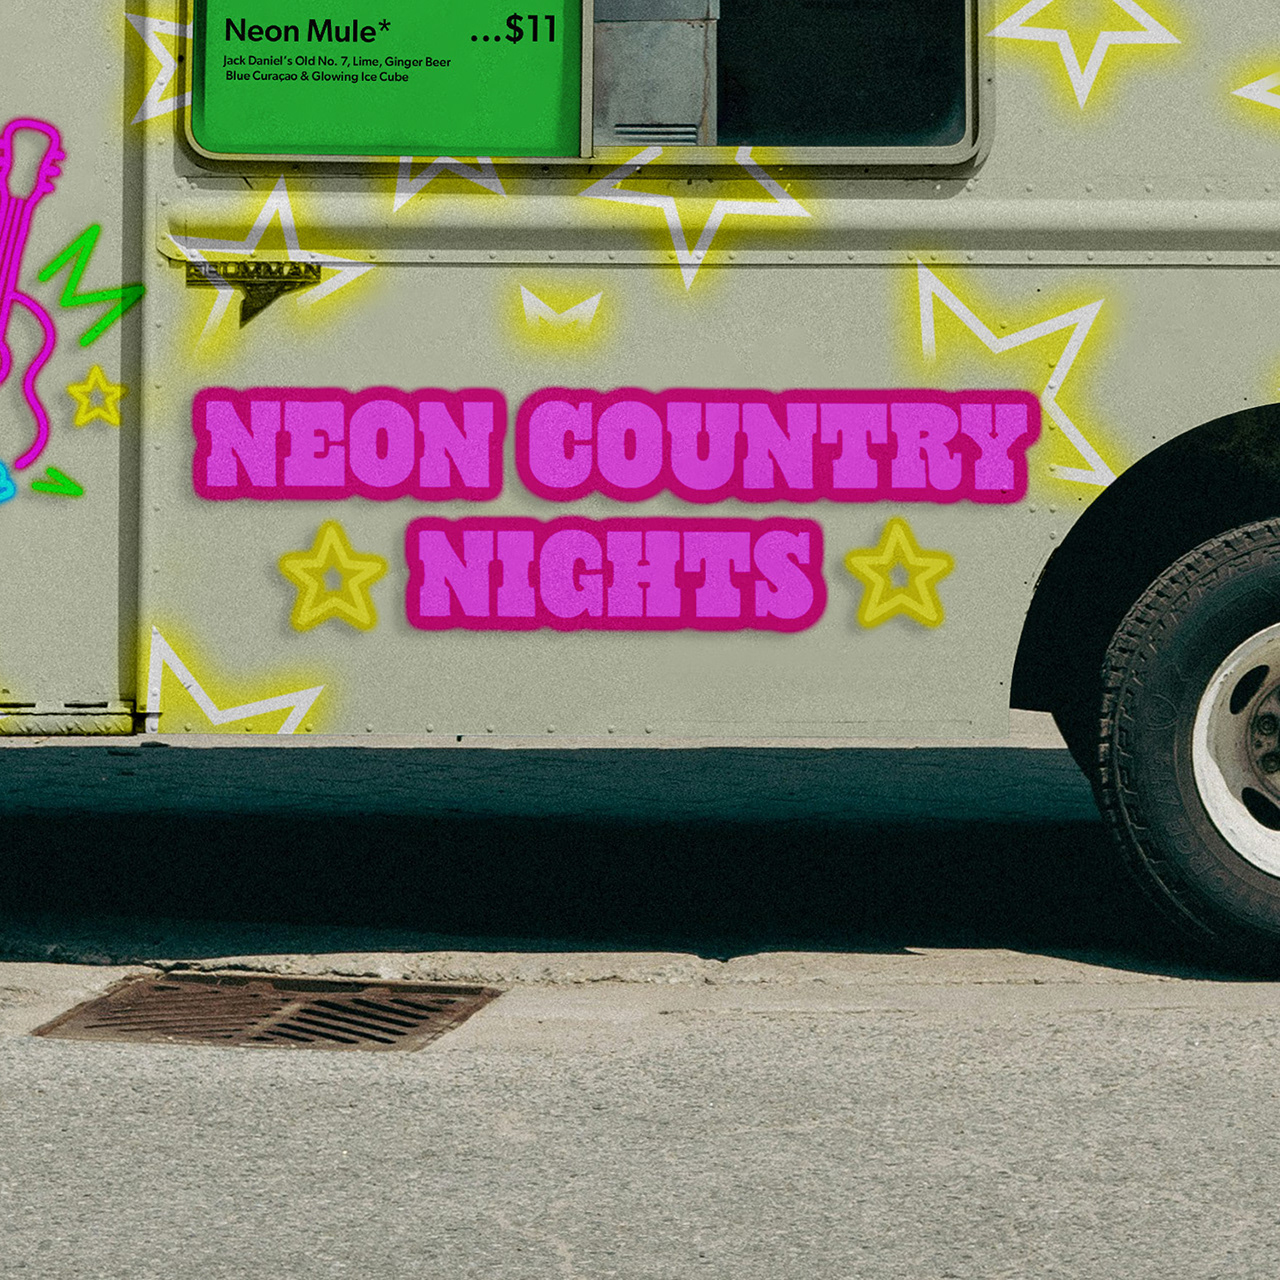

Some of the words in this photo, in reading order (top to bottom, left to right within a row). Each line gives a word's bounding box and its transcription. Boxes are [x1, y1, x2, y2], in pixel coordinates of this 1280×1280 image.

[225, 17, 300, 43] Neon
[223, 55, 246, 67] Jack
[248, 55, 293, 66] Daniel's
[295, 55, 316, 66] Old
[318, 56, 338, 66] No.
[341, 56, 351, 68] 7,
[353, 57, 383, 68] Lime,
[385, 56, 424, 70] Ginger
[426, 57, 452, 67] Beer
[225, 70, 251, 81] Blue
[252, 70, 298, 83] Curaçao
[300, 71, 310, 82] &
[311, 71, 359, 84] Glowing
[361, 72, 378, 82] Ice
[379, 71, 410, 82] Cube
[204, 398, 495, 489] NEON
[527, 399, 1029, 492] COUNTRY
[417, 528, 815, 621] NIGHTS
